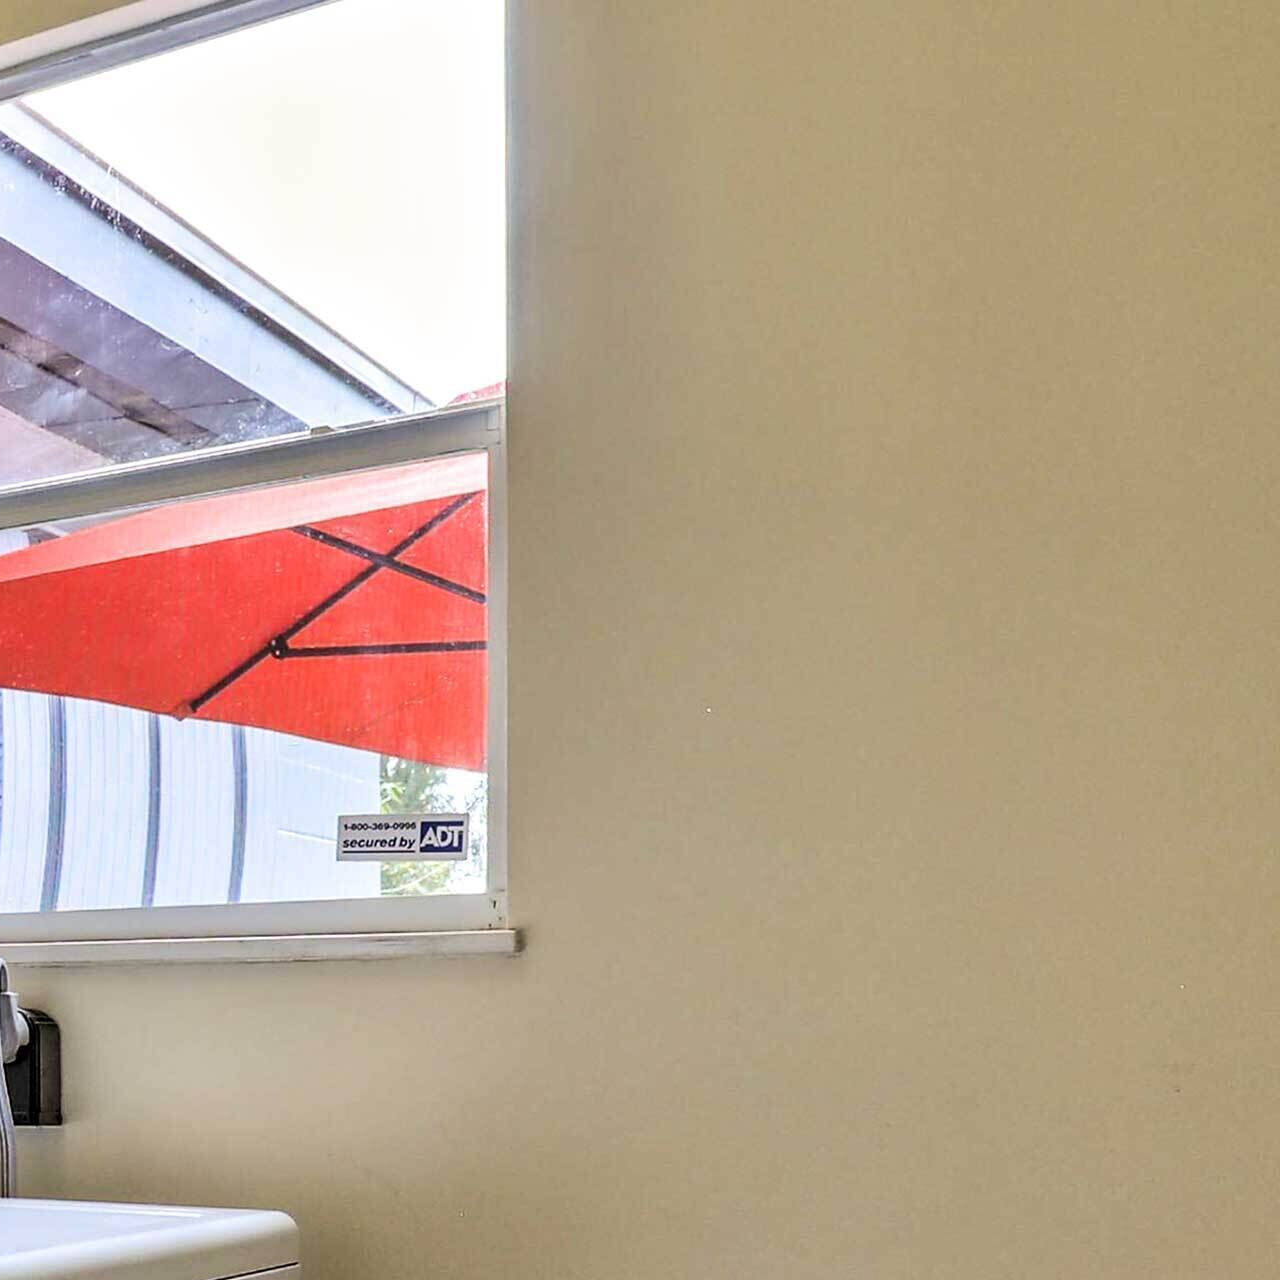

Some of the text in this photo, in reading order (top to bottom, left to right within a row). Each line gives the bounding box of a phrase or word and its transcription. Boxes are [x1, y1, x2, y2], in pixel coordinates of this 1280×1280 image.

[342, 836, 416, 850] secured by
[419, 826, 464, 848] ADT
